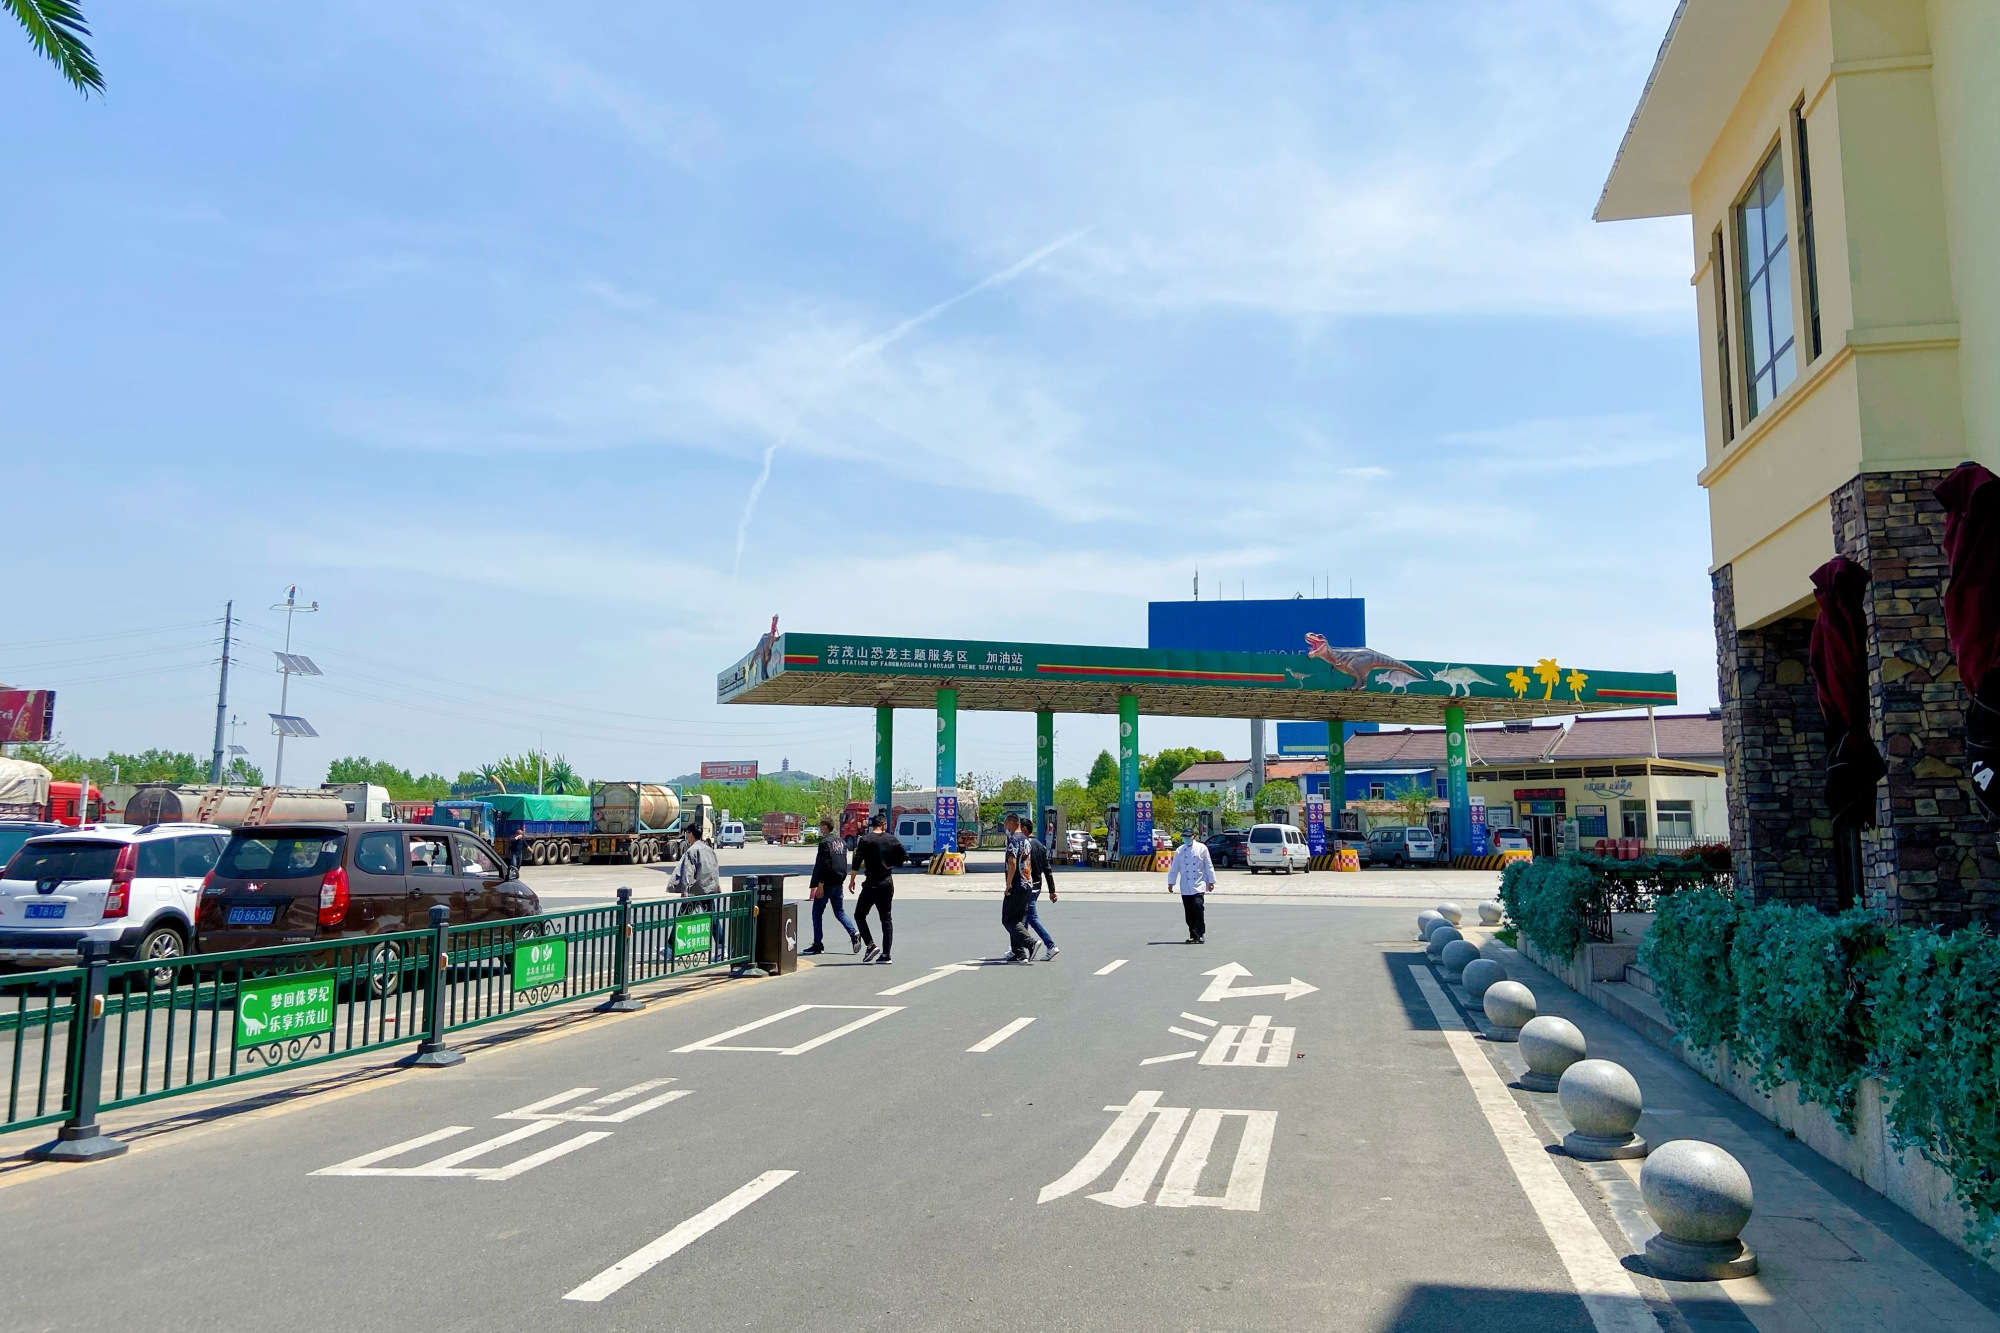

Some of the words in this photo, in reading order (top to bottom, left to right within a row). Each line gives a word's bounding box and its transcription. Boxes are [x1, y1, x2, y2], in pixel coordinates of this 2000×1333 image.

[827, 644, 968, 662] 芳茂山恐龙主题服务区
[986, 650, 1024, 666] 加油站
[270, 986, 330, 1011] 梦回侏罗纪
[268, 1007, 329, 1033] 乐享芳茂山
